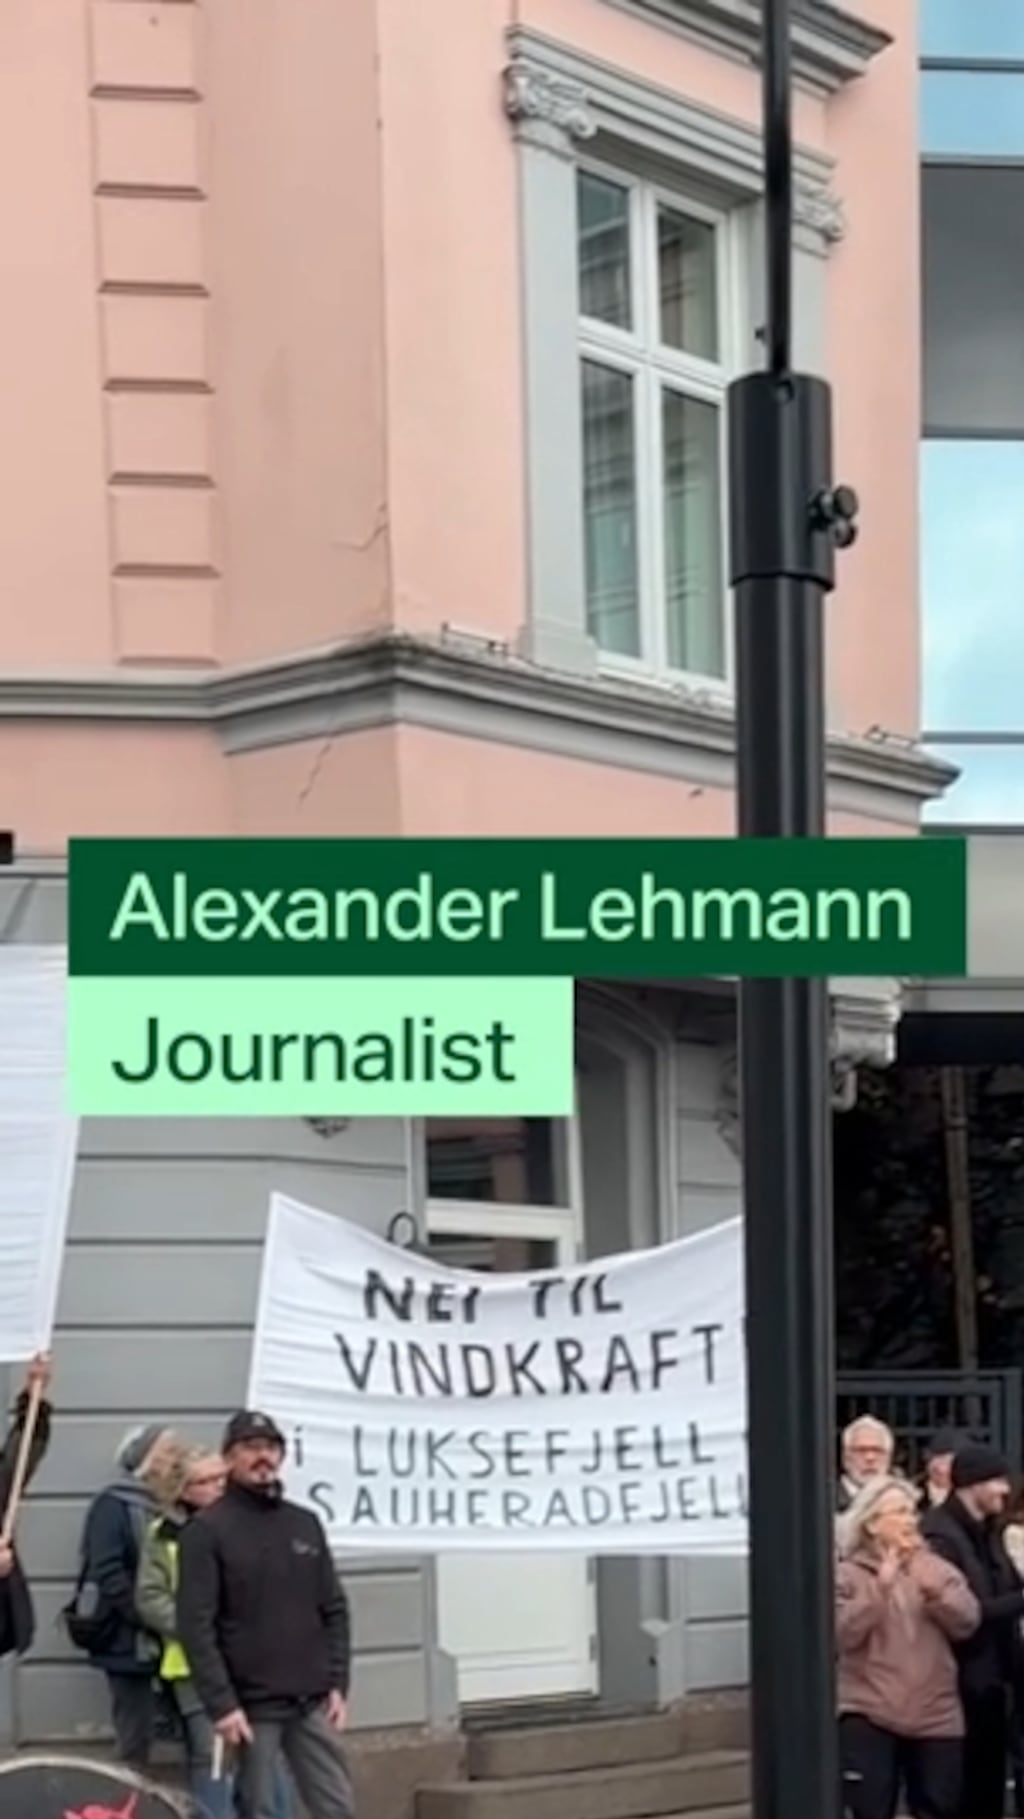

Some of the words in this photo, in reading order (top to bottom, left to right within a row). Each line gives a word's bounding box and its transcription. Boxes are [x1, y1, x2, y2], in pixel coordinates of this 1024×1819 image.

[363, 1269, 481, 1323] NEI
[528, 1273, 622, 1319] TIL
[333, 1323, 723, 1398] VINDKRAFT
[353, 1421, 716, 1480] LUKSEFJELL
